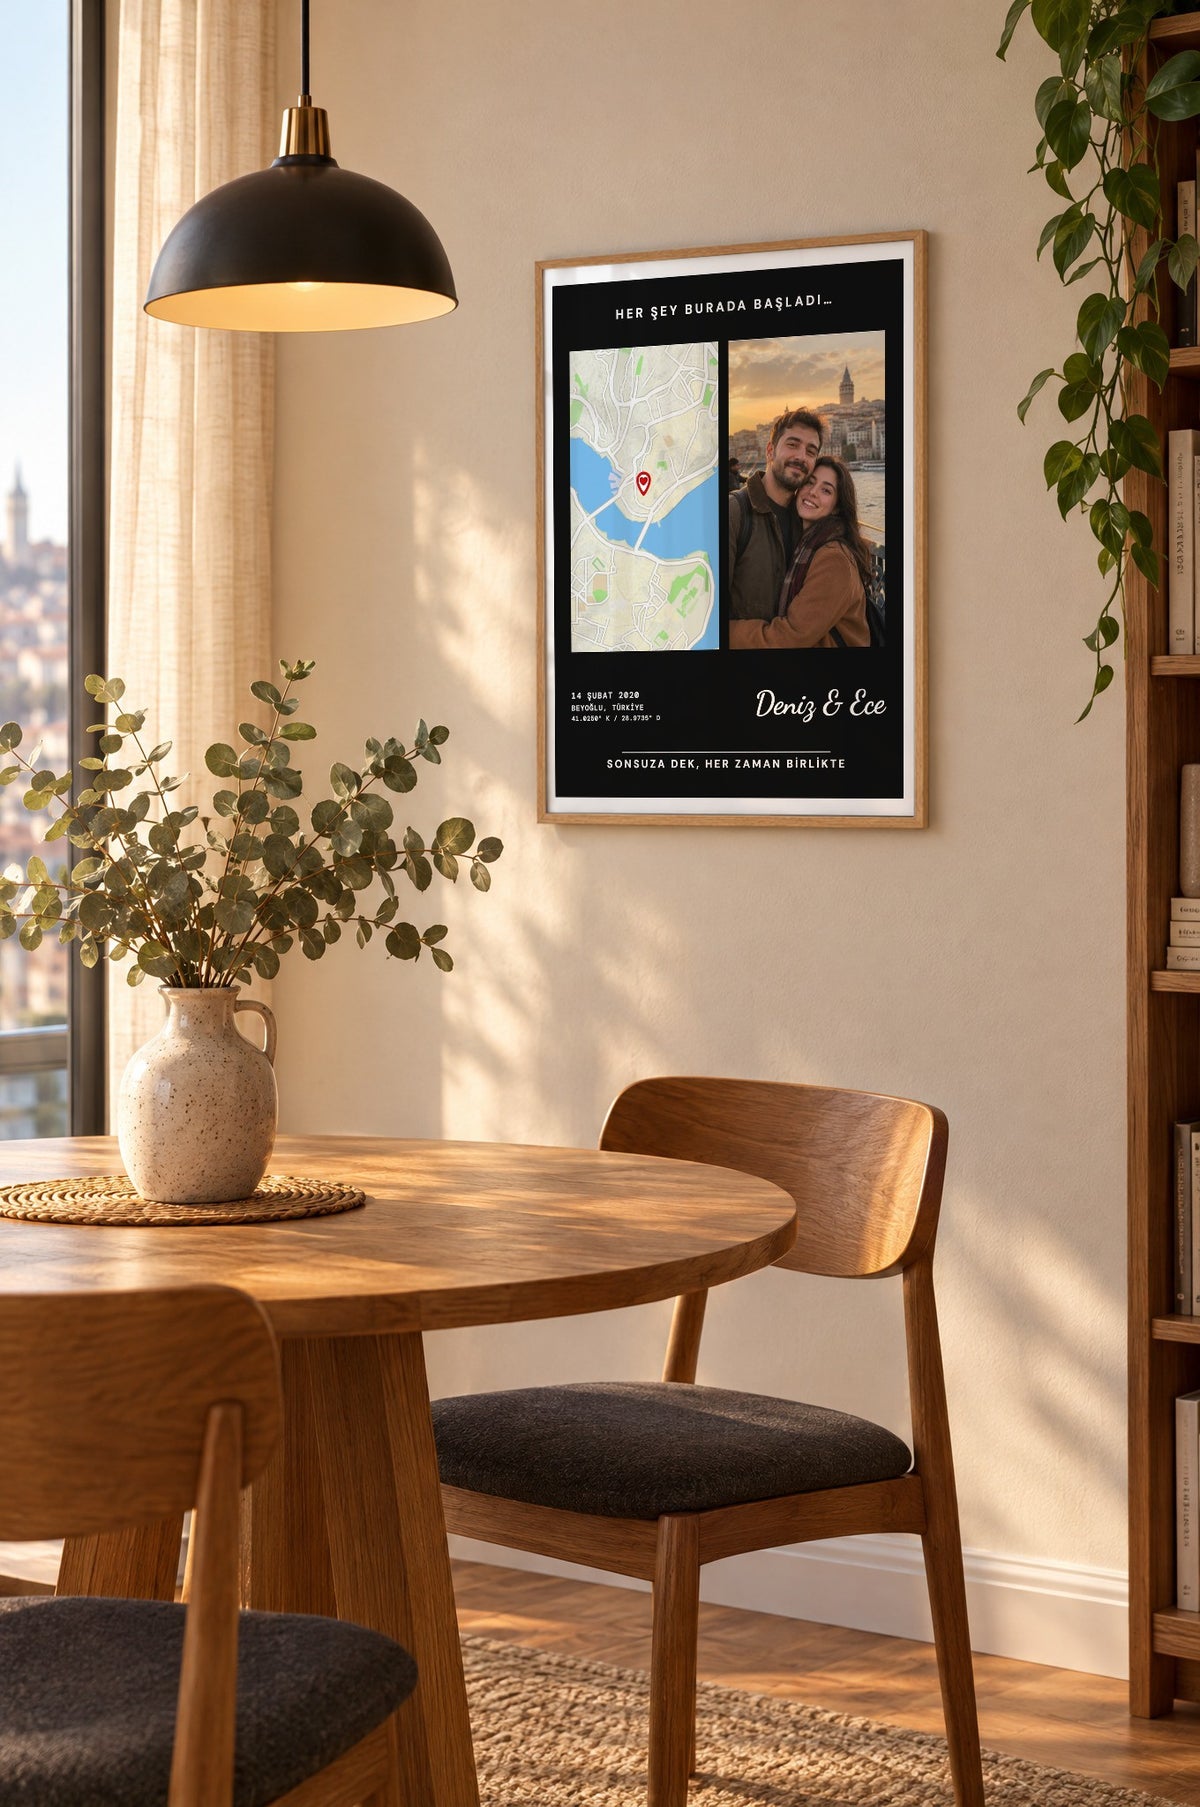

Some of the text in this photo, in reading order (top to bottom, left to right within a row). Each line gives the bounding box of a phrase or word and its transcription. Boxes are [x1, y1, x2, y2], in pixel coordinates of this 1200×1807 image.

[616, 307, 644, 320] HER
[650, 304, 678, 321] ŞEY
[685, 299, 747, 315] BURADA
[571, 690, 640, 702] 14 ŞUBAT 2020
[571, 702, 645, 712] BEYOĞLU, TÜRKİYE
[755, 688, 887, 724] Deniz & Ece
[605, 714, 611, 722] K
[606, 757, 846, 770] SONSUZA DEK, HER ZAMAN BİRLİKTE
